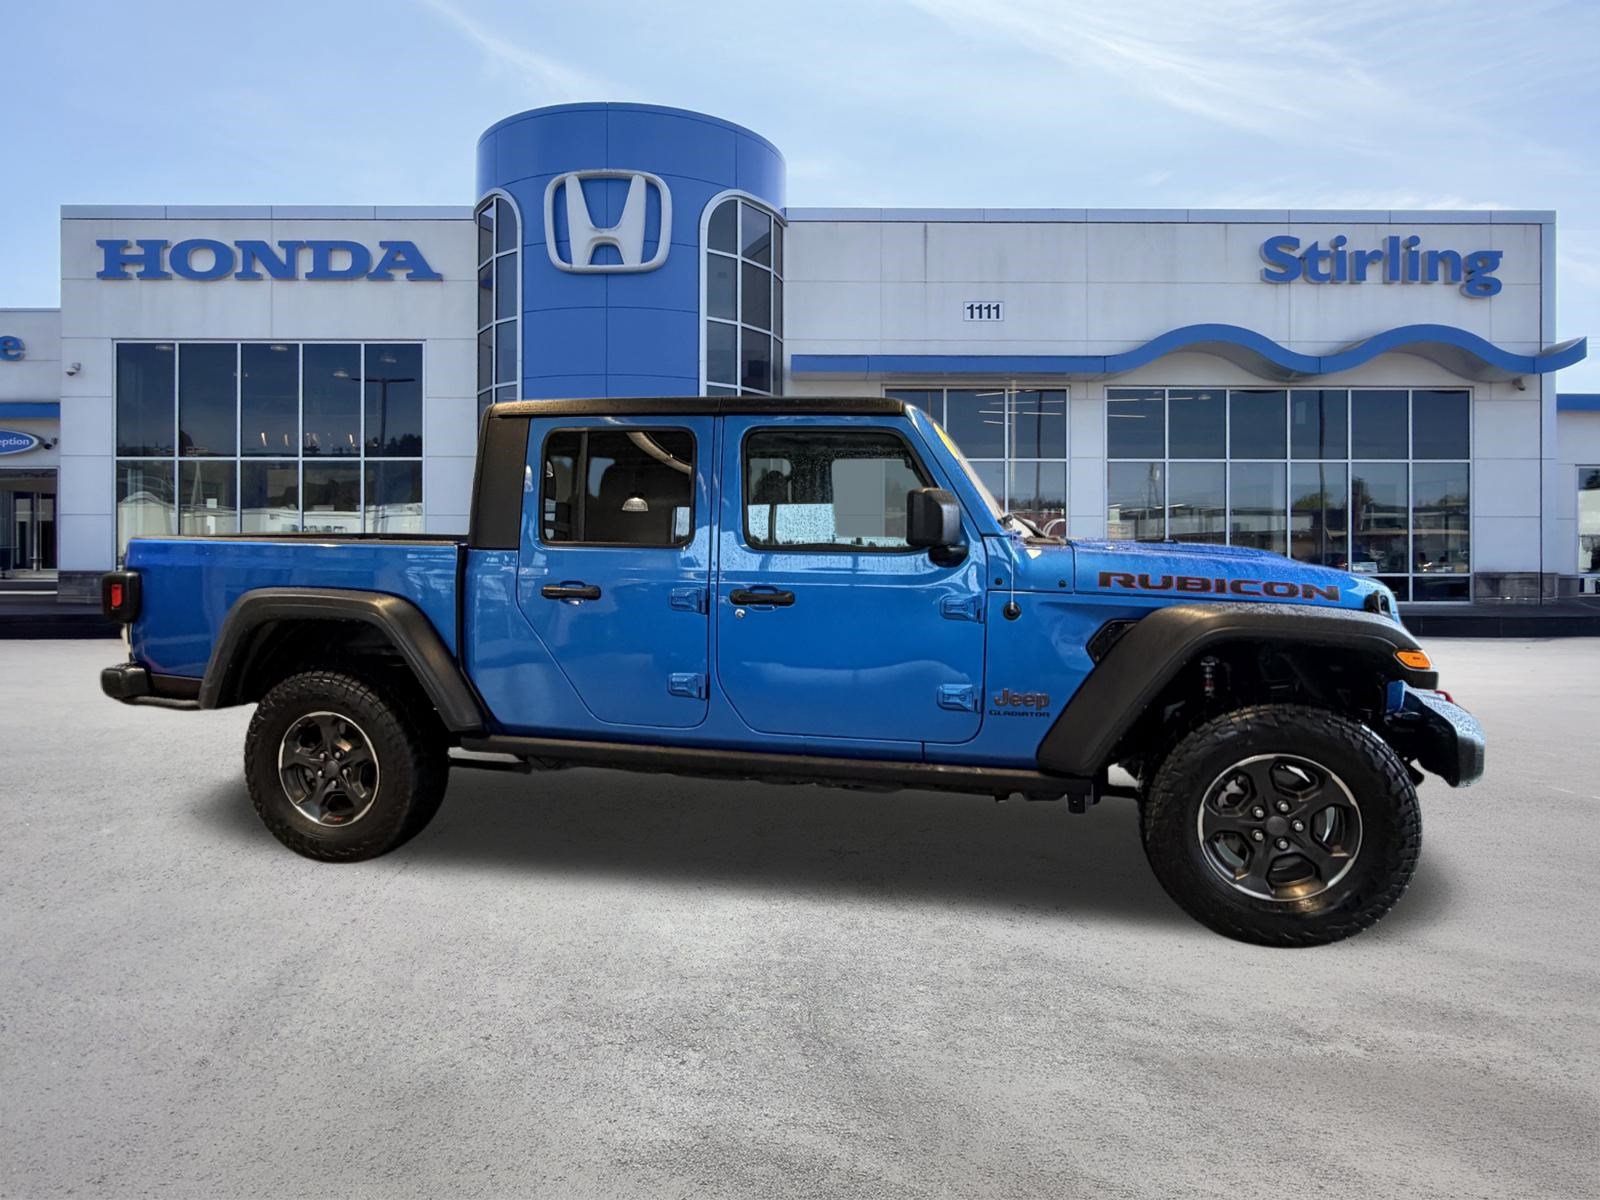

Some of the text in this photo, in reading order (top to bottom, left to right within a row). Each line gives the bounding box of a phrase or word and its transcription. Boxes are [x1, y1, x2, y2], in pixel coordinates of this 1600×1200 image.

[96, 239, 443, 281] HONDA
[1261, 235, 1503, 298] Stirling
[966, 303, 1000, 320] 1111
[0, 437, 30, 448] ption
[1098, 571, 1340, 601] RUBICON
[994, 687, 1050, 711] Jeep
[989, 709, 1050, 718] GLADIATOR
